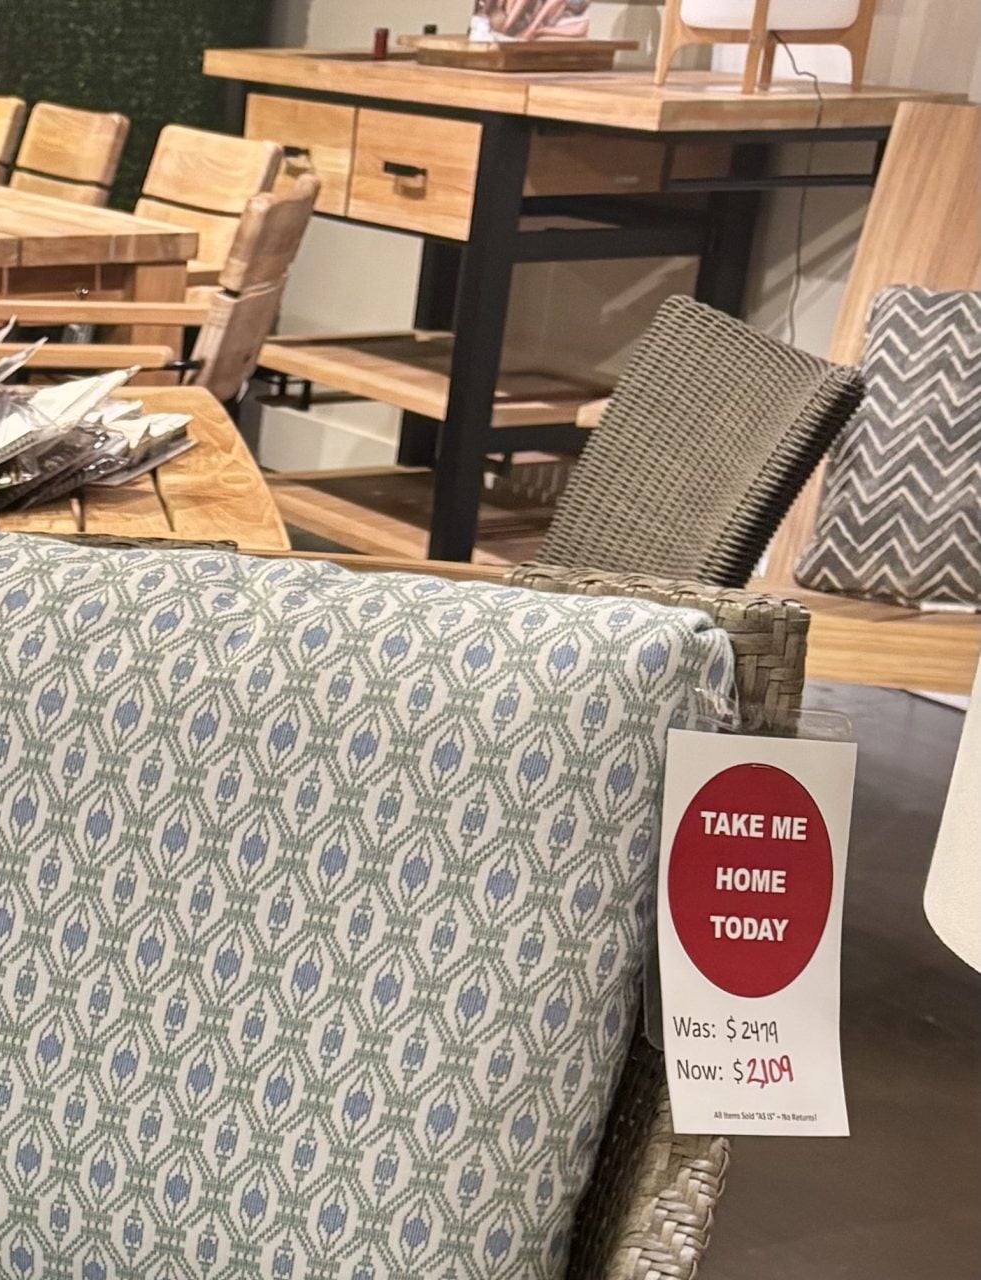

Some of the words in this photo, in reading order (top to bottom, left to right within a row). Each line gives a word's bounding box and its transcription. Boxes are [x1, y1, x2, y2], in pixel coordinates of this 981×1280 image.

[700, 811, 764, 837] TAKE
[771, 815, 807, 840] ME
[715, 867, 786, 893] HOME
[710, 915, 789, 941] TODAY
[673, 1016, 716, 1038] Was:
[677, 1059, 723, 1080] Now:
[714, 1111, 722, 1119] All
[741, 1112, 755, 1120] Sold
[782, 1113, 791, 1121] No
